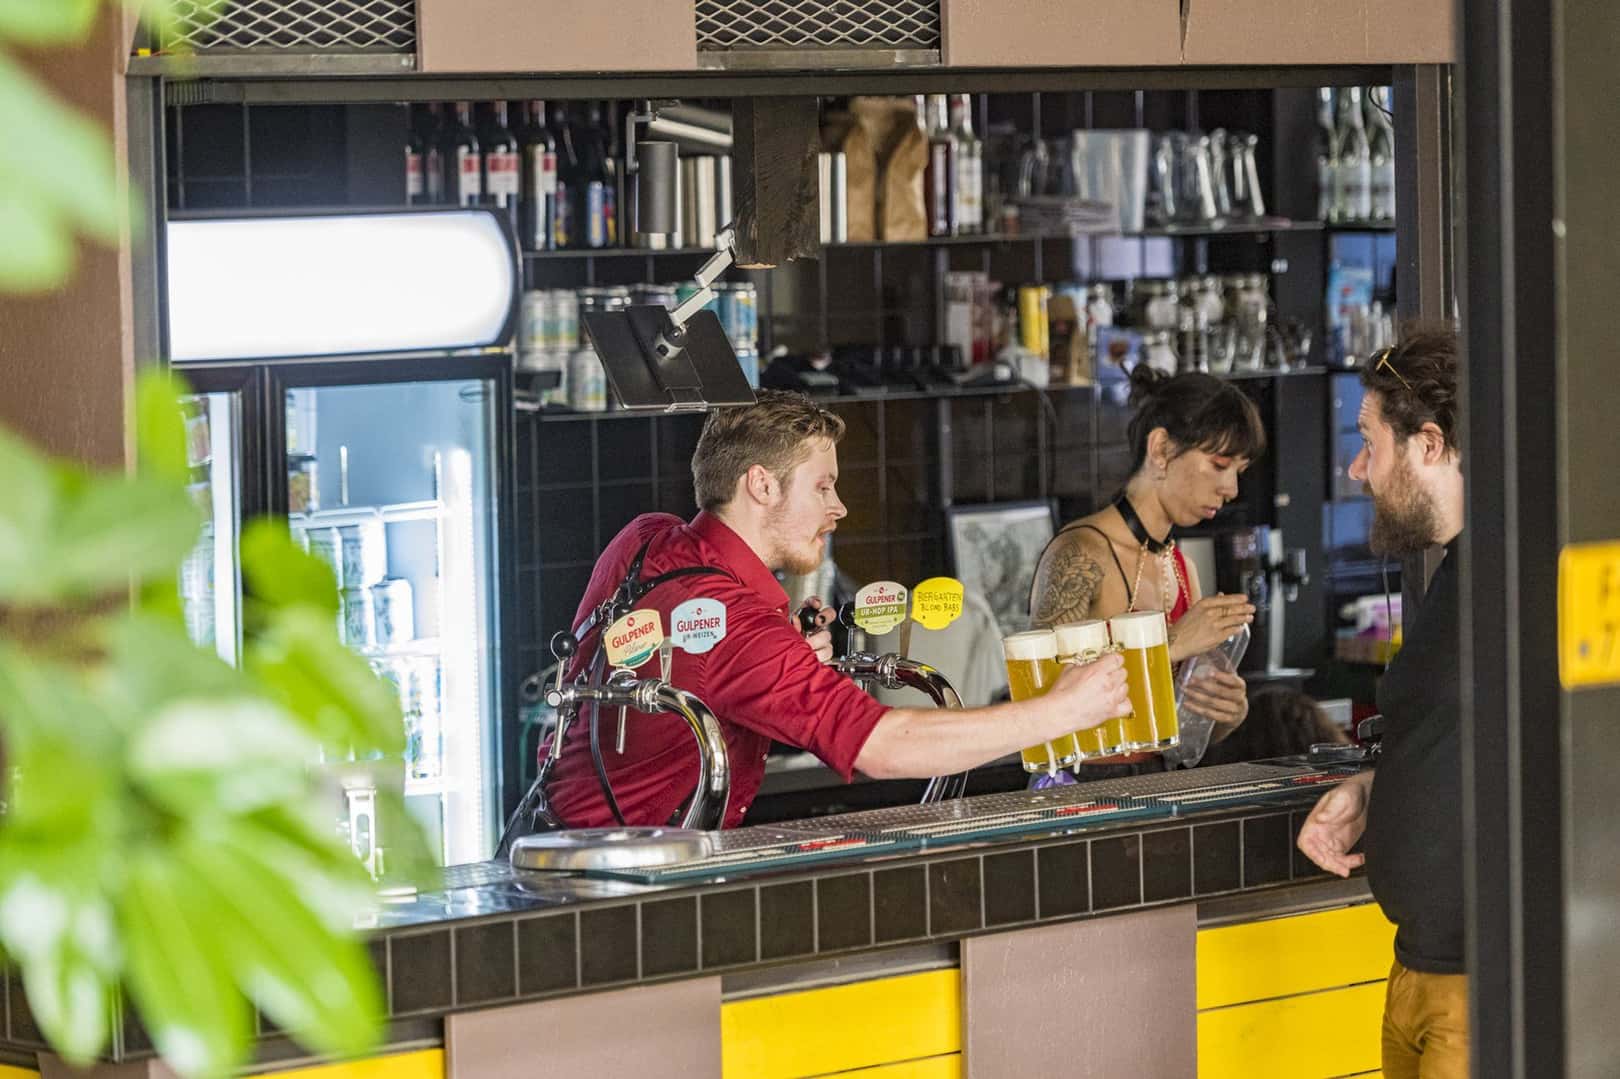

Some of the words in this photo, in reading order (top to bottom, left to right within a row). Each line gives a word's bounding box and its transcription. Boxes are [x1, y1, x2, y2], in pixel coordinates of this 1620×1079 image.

[865, 594, 896, 605] GULPENER
[917, 591, 962, 602] BIERGARTEN
[887, 606, 898, 614] IPA
[677, 617, 720, 632] GULPENER
[612, 622, 655, 648] GULPENER
